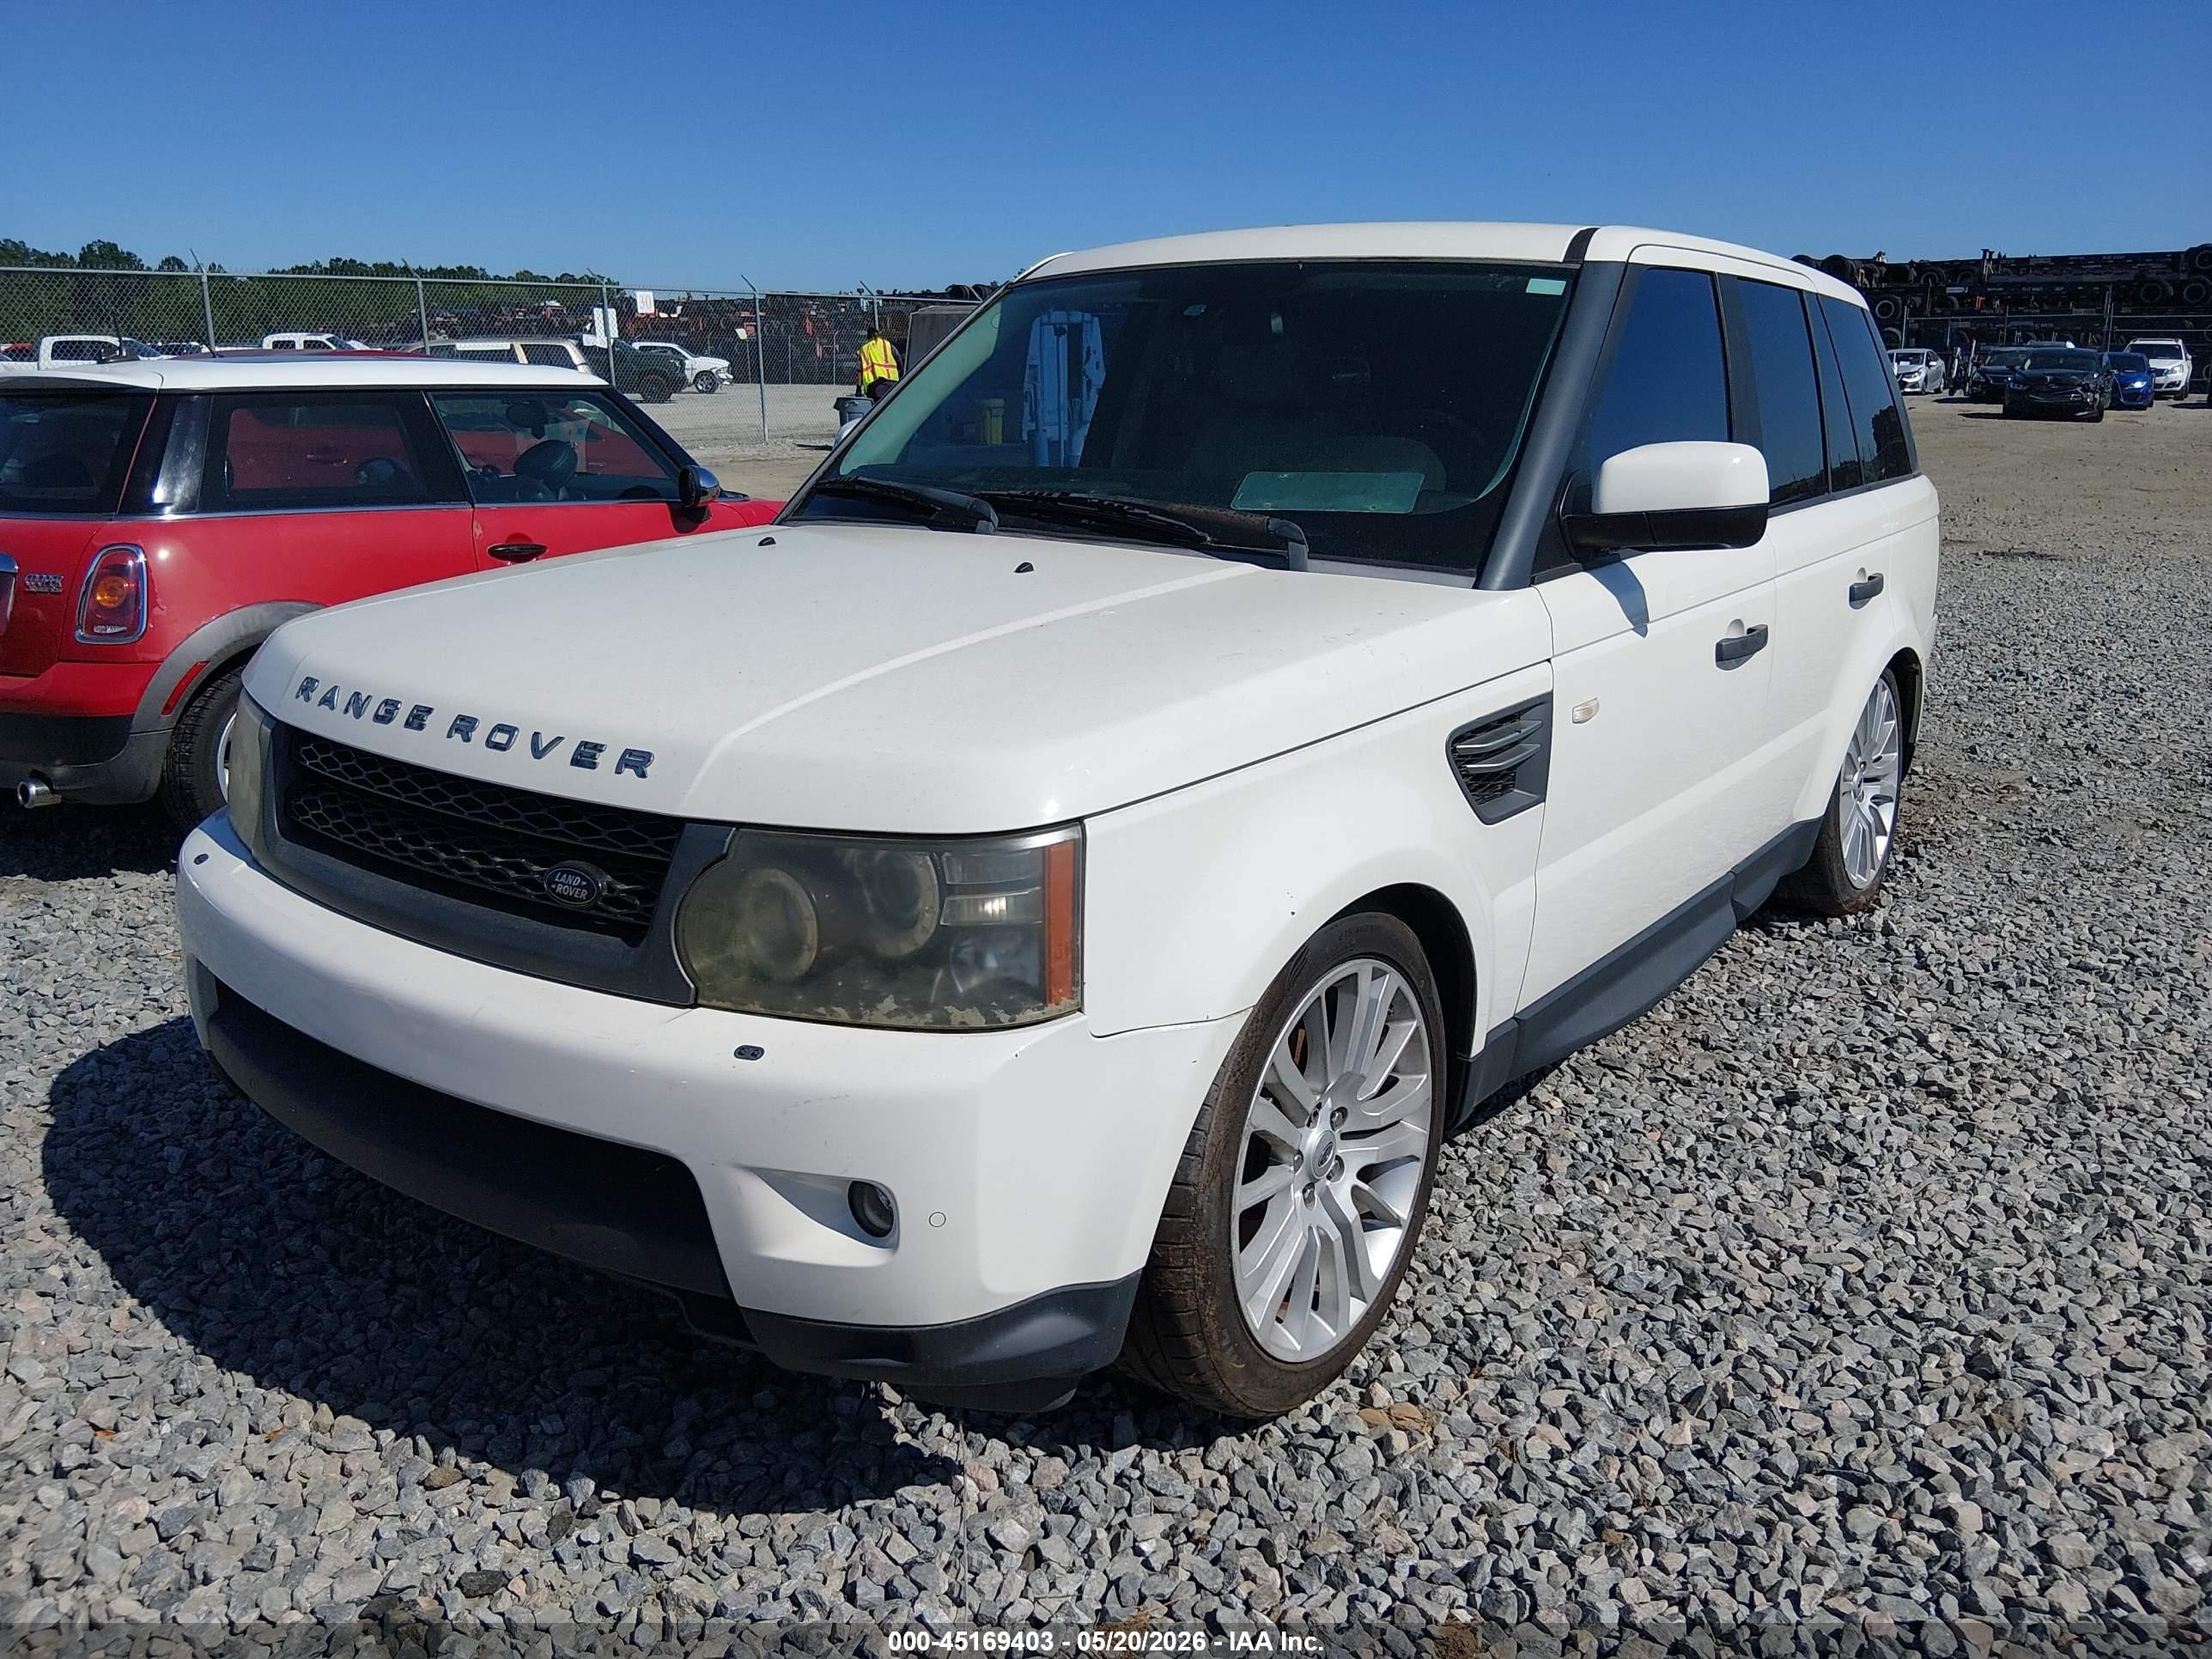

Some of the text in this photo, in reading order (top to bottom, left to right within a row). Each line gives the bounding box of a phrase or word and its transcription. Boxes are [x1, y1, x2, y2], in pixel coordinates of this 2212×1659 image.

[639, 295, 652, 309] 30
[295, 676, 654, 779] RANGE ROVER
[555, 872, 581, 886] LAND
[556, 884, 588, 899] ROVER
